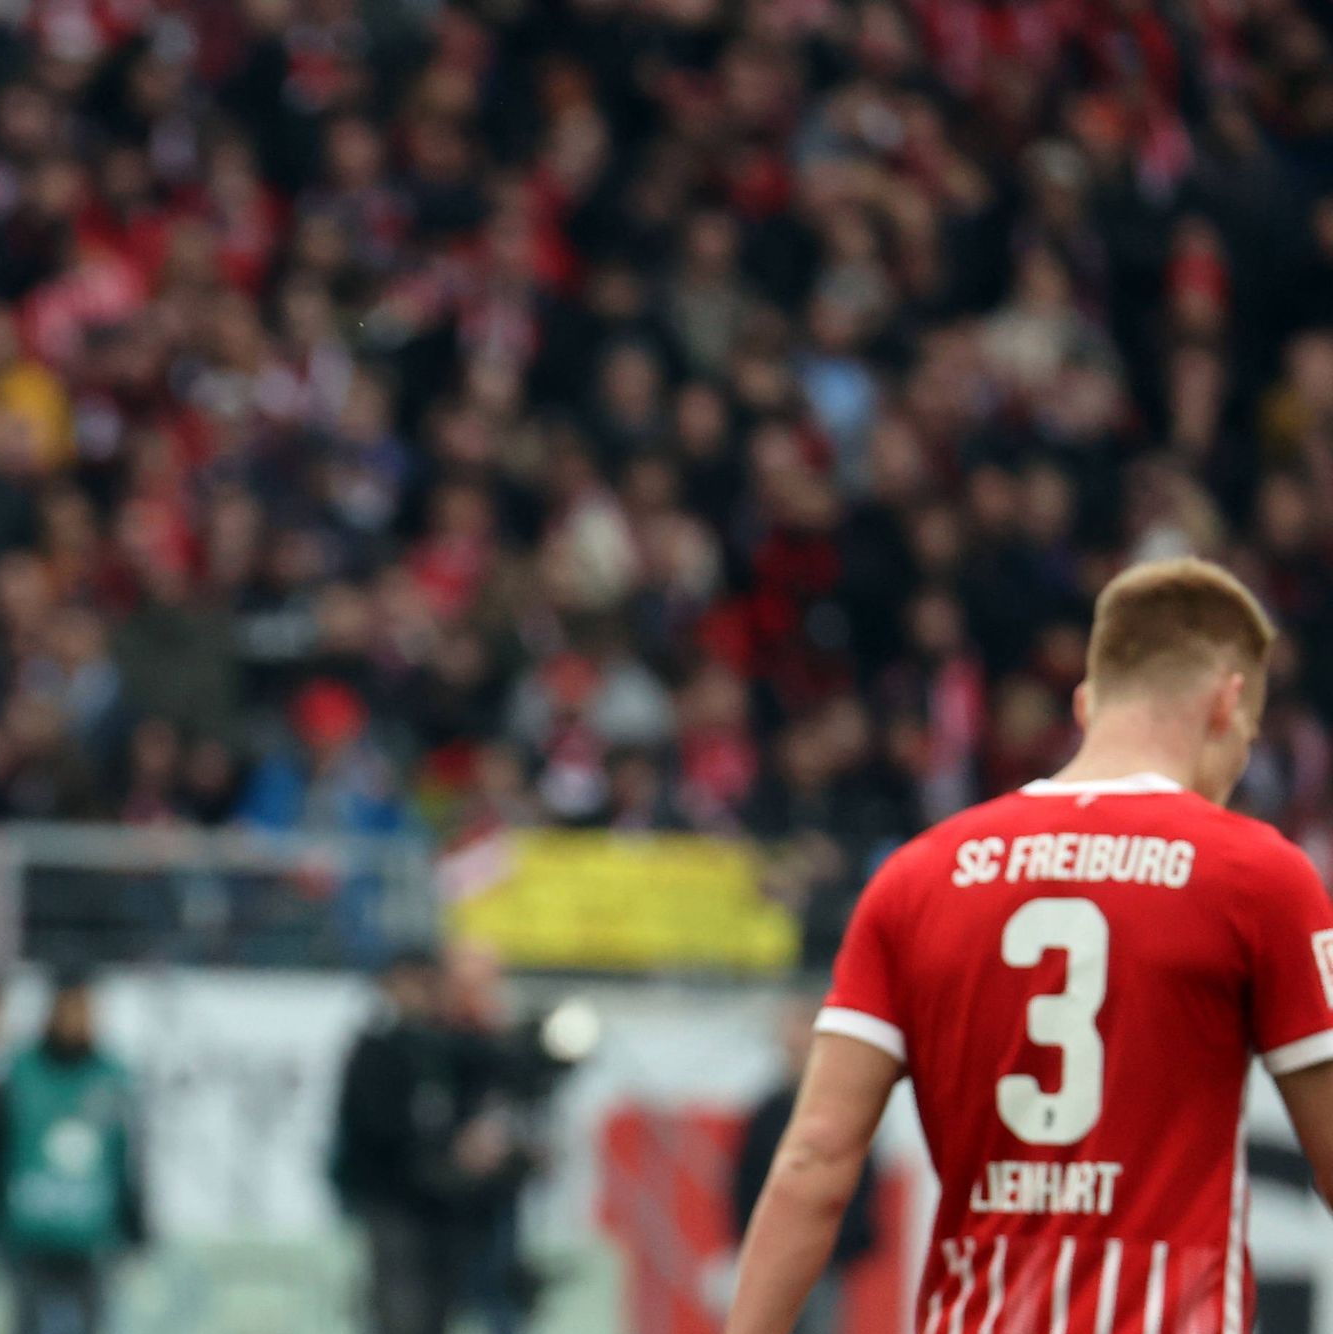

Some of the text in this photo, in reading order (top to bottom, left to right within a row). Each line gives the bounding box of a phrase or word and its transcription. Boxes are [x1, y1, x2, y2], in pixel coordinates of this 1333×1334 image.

[952, 833, 1195, 888] SC FREIBURG
[996, 898, 1109, 1145] 3
